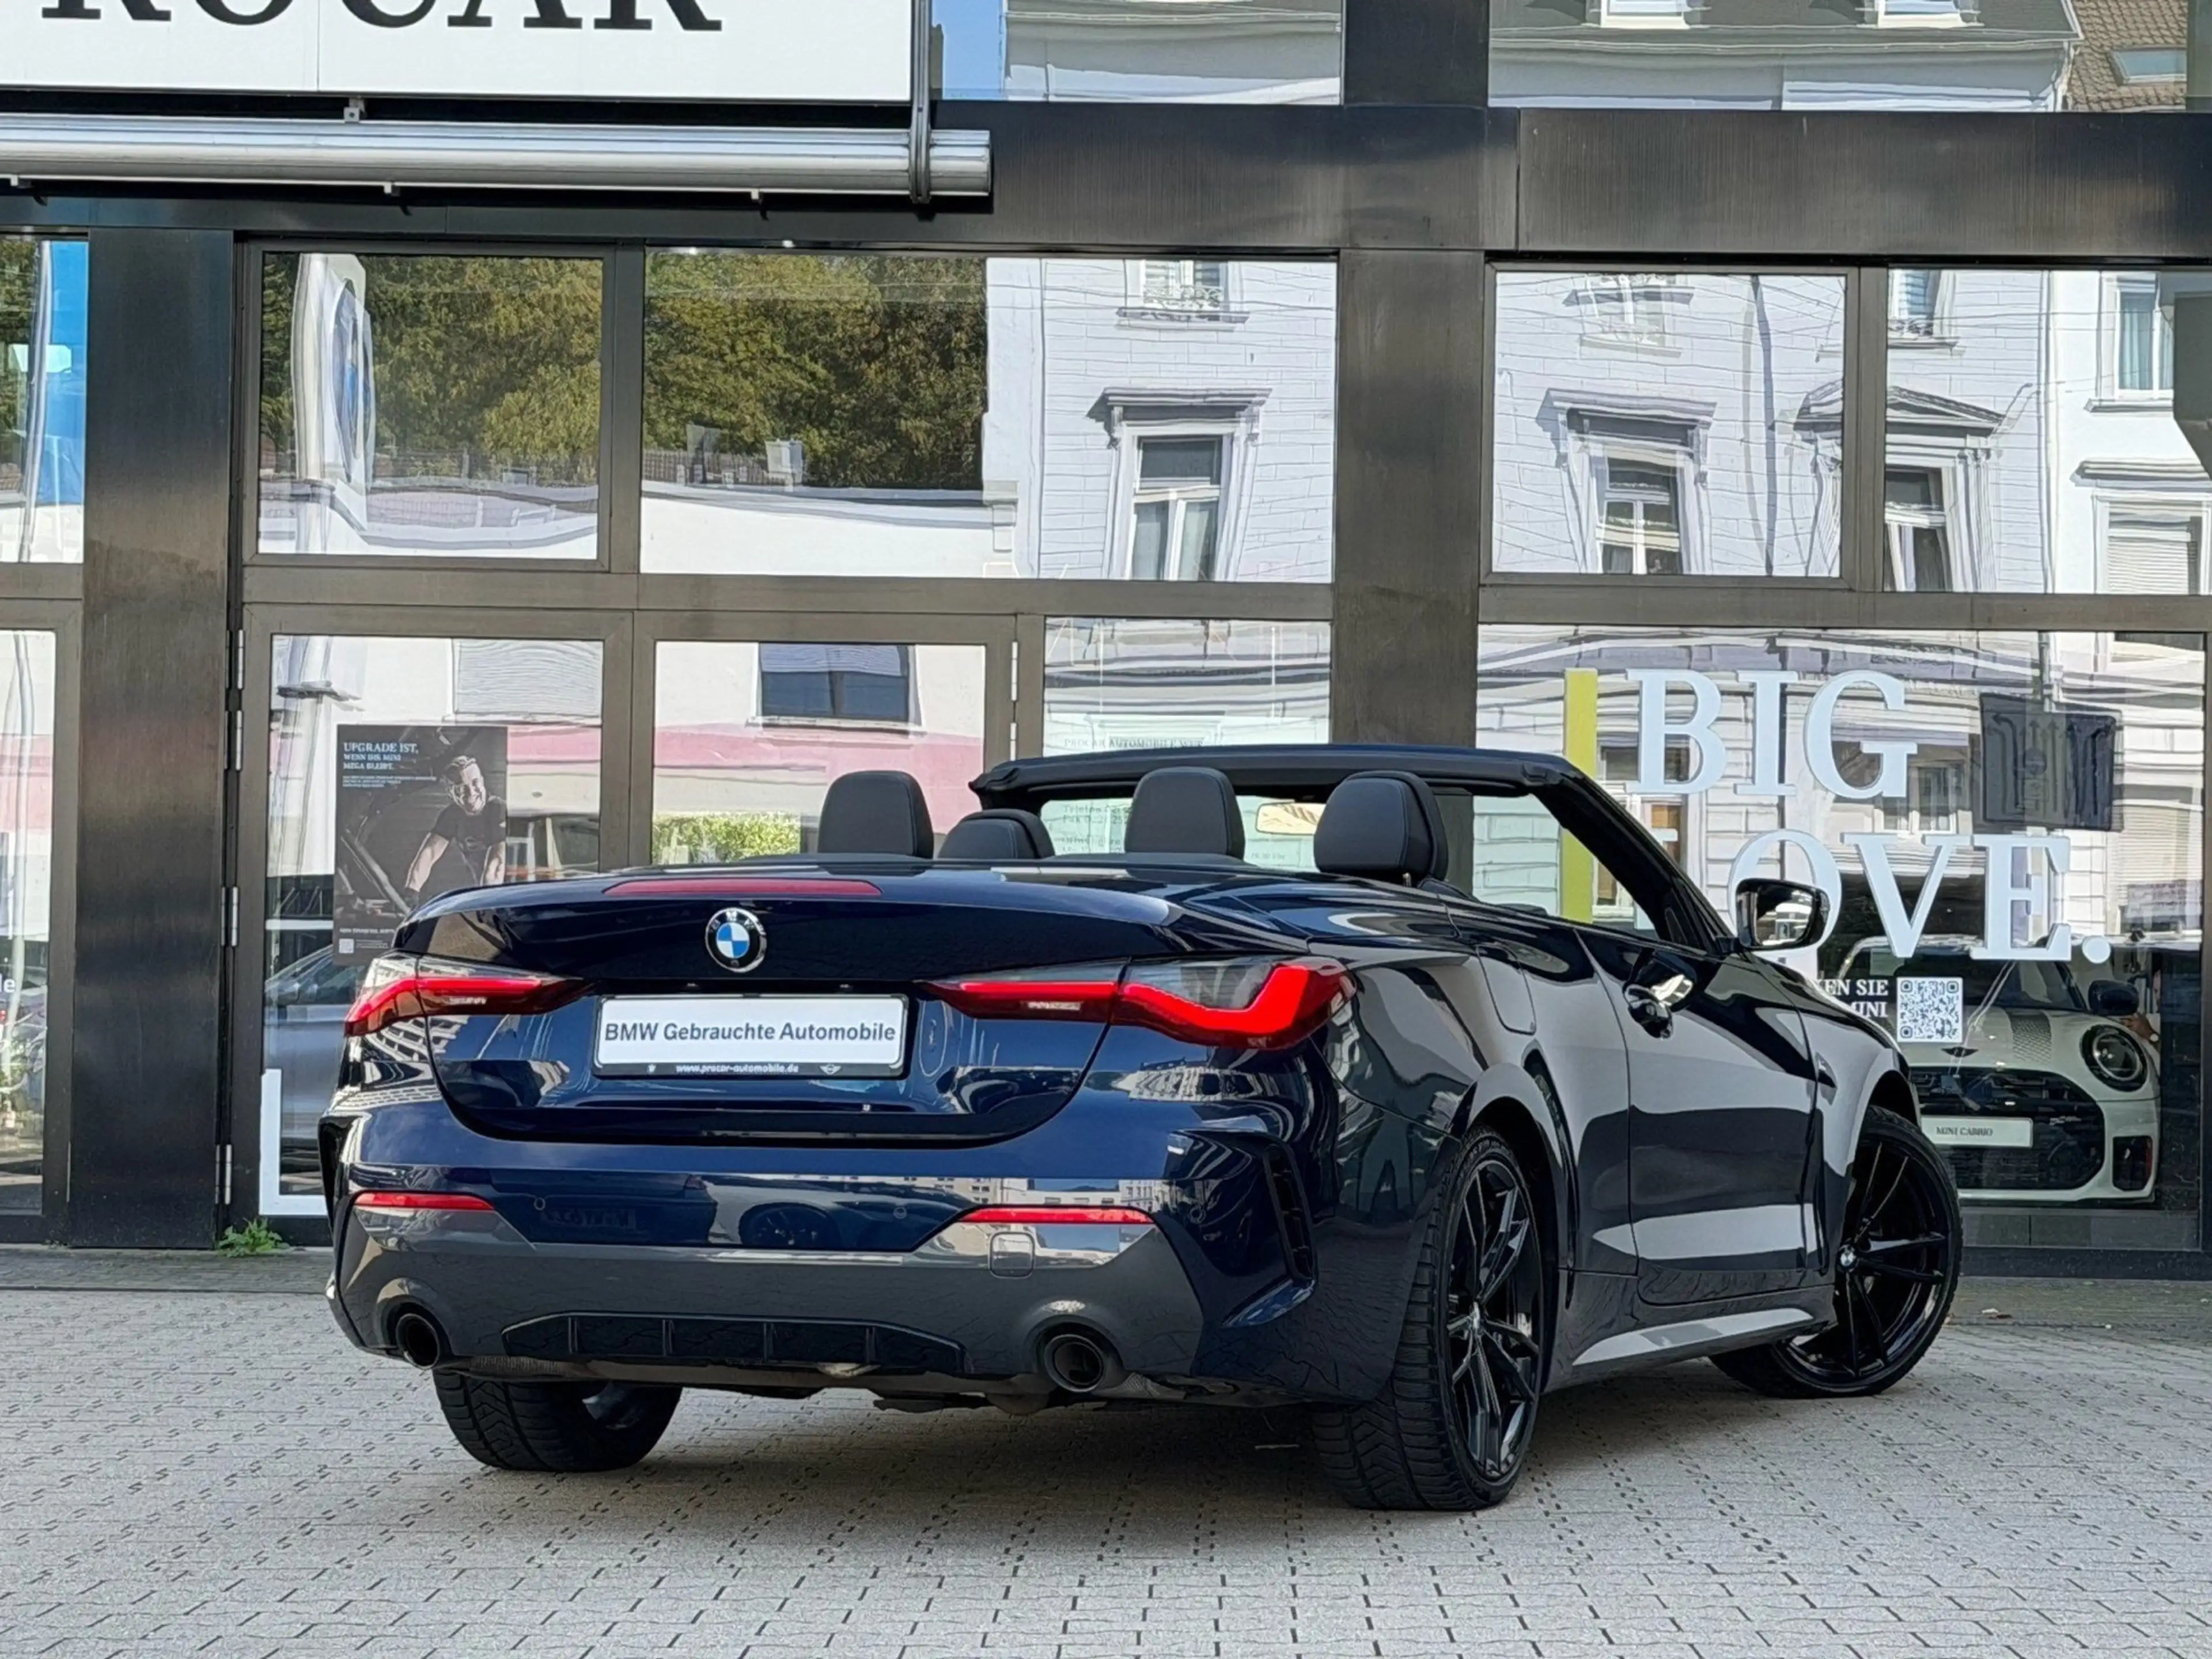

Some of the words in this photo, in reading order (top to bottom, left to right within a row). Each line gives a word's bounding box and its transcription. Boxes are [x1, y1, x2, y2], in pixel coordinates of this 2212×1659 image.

[1625, 669, 1918, 798] BIG
[343, 742, 397, 752] UPGRADE
[399, 743, 419, 754] IST,
[1634, 828, 2111, 964] OVE.
[1856, 979, 1888, 996] SIE
[1850, 1001, 1889, 1018] INI
[604, 1023, 658, 1041] BMW
[664, 1023, 775, 1041] Gebrauchte
[779, 1022, 896, 1041] Automobile
[1936, 1126, 1957, 1135] MINI
[1959, 1127, 1993, 1137] CABRIO
